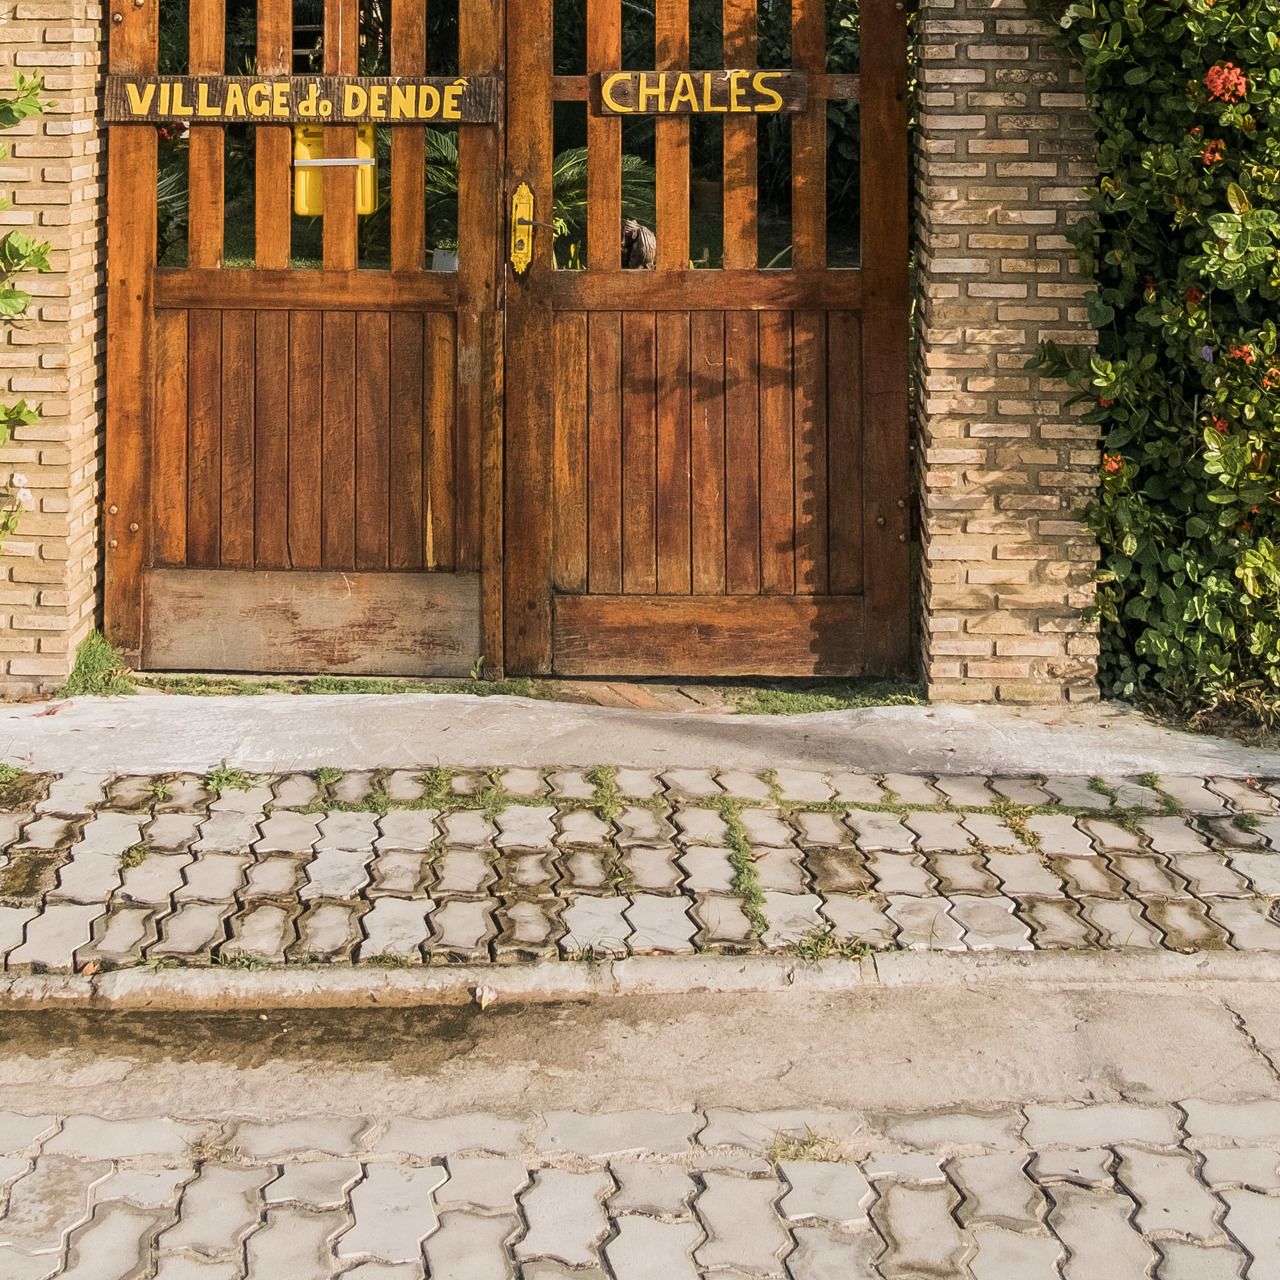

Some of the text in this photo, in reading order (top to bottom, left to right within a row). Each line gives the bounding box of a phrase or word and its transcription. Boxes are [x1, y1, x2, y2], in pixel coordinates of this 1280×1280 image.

[126, 78, 469, 119] VILLAGE do DENDÊ
